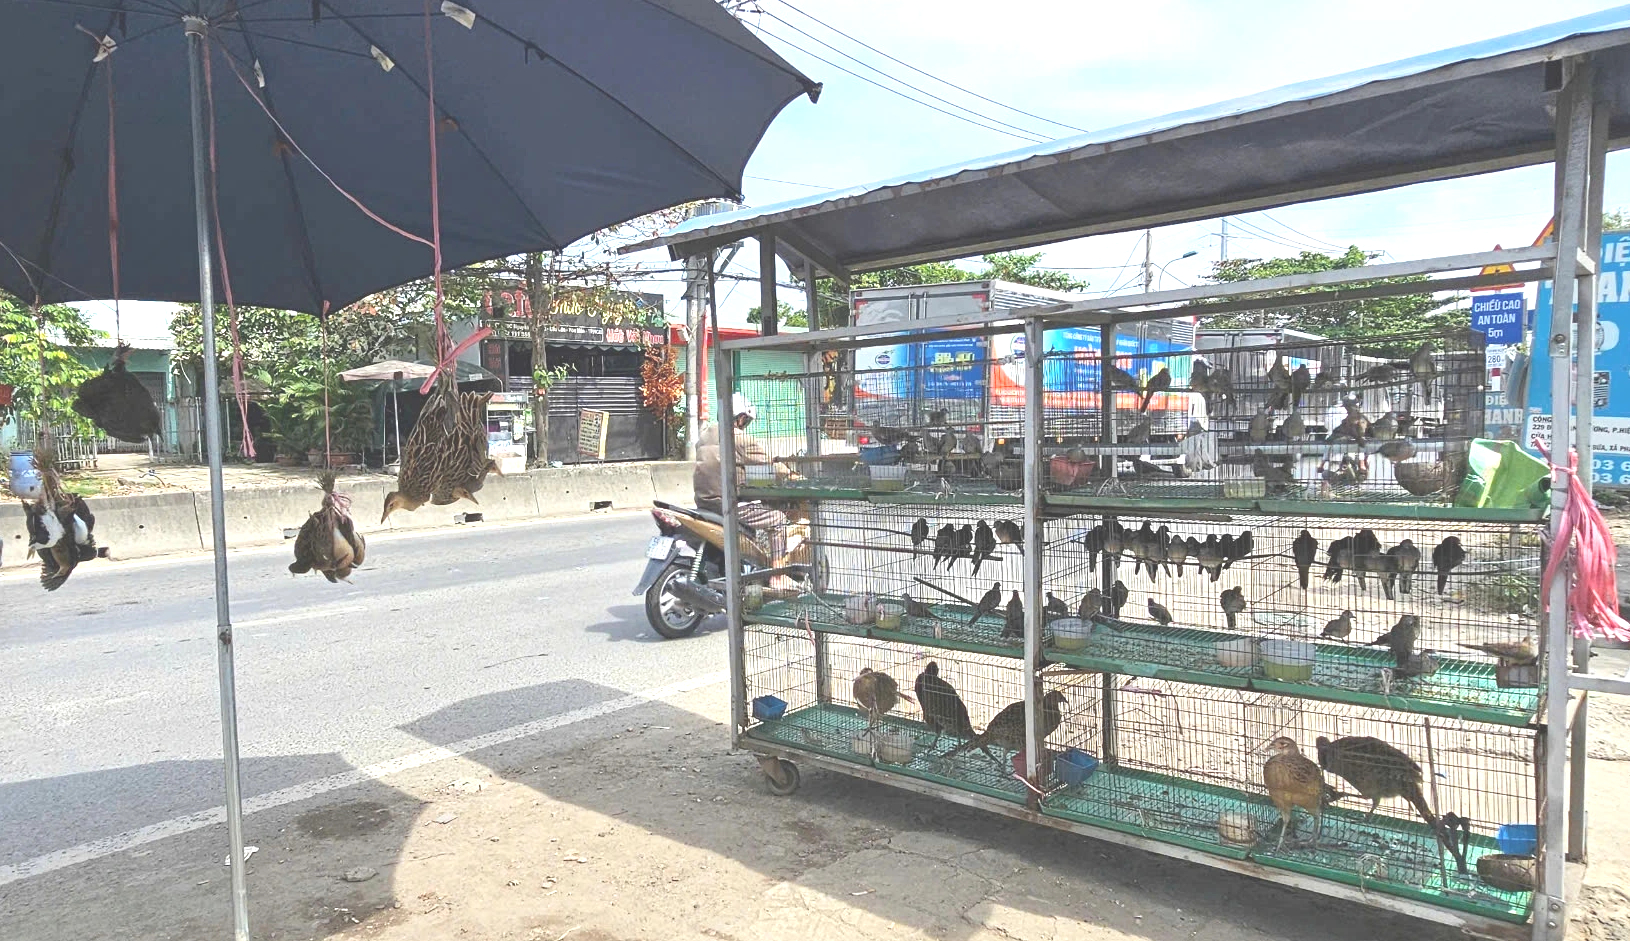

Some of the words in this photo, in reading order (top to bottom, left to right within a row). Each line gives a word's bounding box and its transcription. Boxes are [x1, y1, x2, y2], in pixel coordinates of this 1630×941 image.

[1502, 299, 1521, 310] CAO
[1477, 315, 1490, 325] AN
[1491, 312, 1516, 324] TOÀN
[1487, 354, 1501, 363] 280
